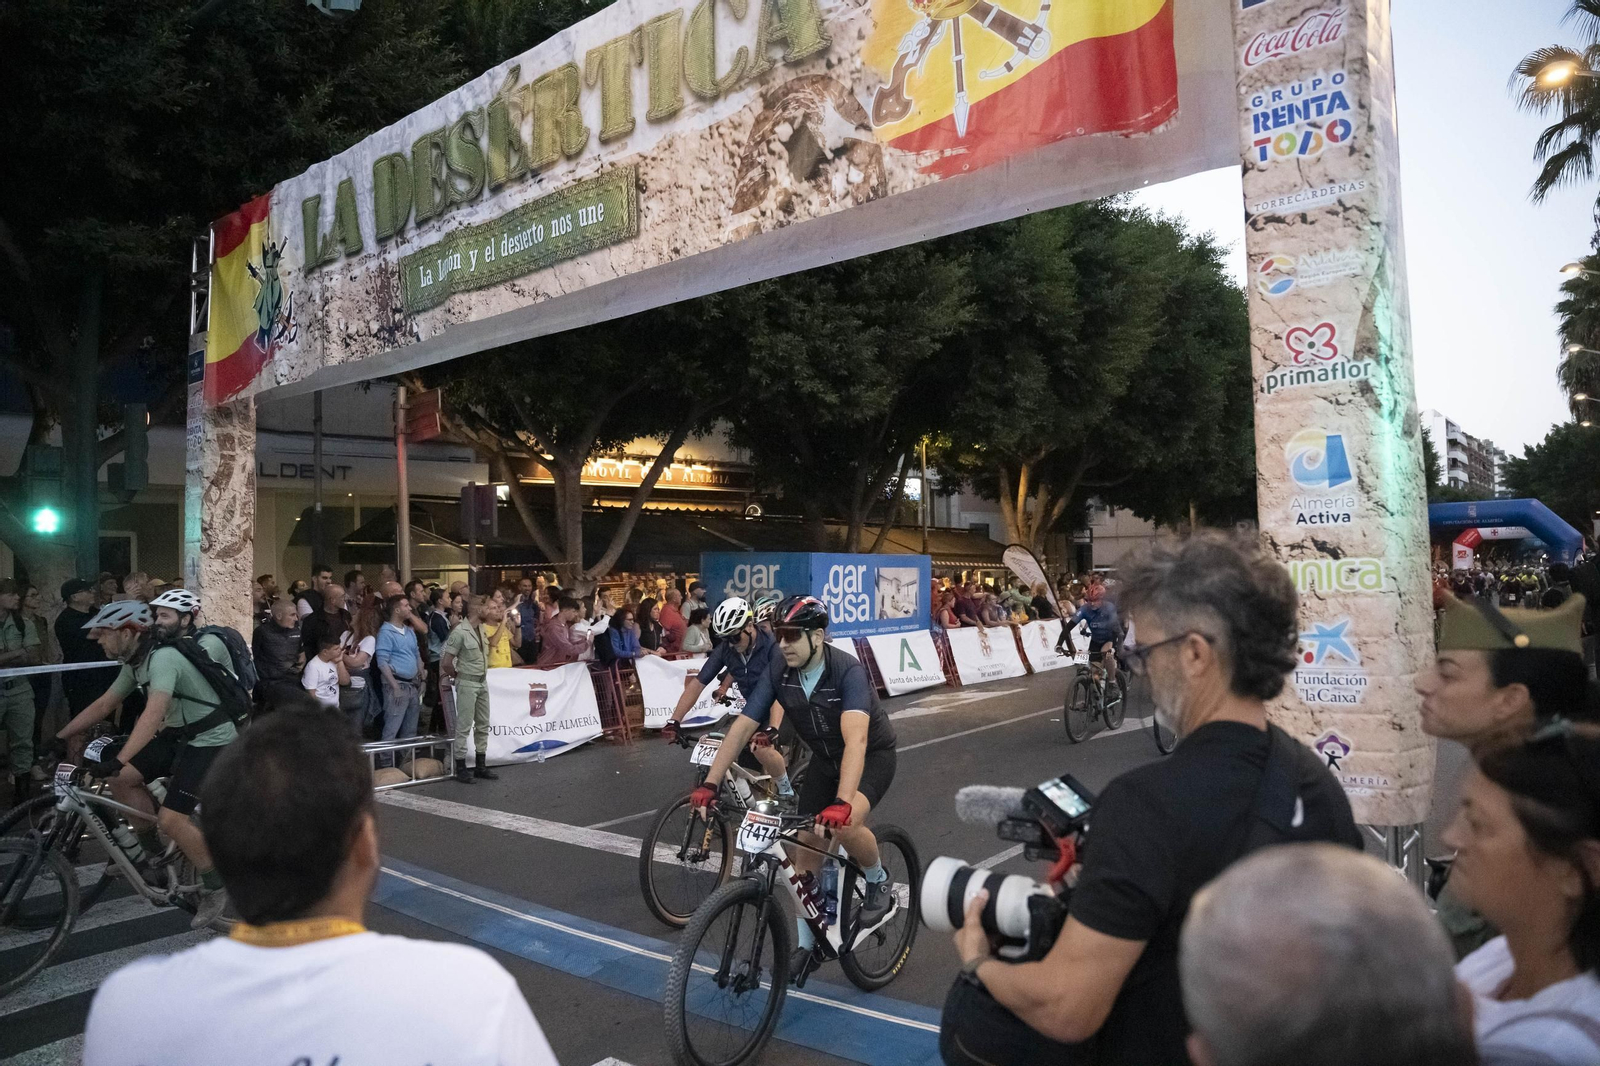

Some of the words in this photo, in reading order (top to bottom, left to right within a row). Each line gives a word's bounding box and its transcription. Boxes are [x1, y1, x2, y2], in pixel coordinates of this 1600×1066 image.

[1251, 72, 1345, 108] GRUPO
[1252, 90, 1351, 134] RENTA
[302, 177, 363, 275] LA
[373, 0, 832, 242] DESÉRTICA
[1253, 118, 1352, 162] TODO
[420, 265, 434, 288] La
[468, 250, 478, 272] y
[484, 237, 496, 263] el
[501, 223, 544, 258] desierto
[551, 212, 573, 239] nos
[578, 202, 605, 228] une
[1266, 361, 1371, 394] primaflor
[256, 461, 352, 481] LDENT
[1291, 494, 1355, 511] Almería
[1296, 511, 1351, 526] Activa
[734, 564, 780, 595] gar
[828, 564, 867, 605] gar
[821, 582, 870, 624] fusa
[889, 677, 905, 685] Junta
[913, 673, 941, 682] Andalucía
[1294, 671, 1367, 687] Fundación
[698, 699, 708, 710] DE
[488, 723, 543, 737] PUTACIÓN
[546, 721, 557, 732] DE
[559, 713, 599, 730] ALMERÍA
[747, 823, 777, 843] 7474
